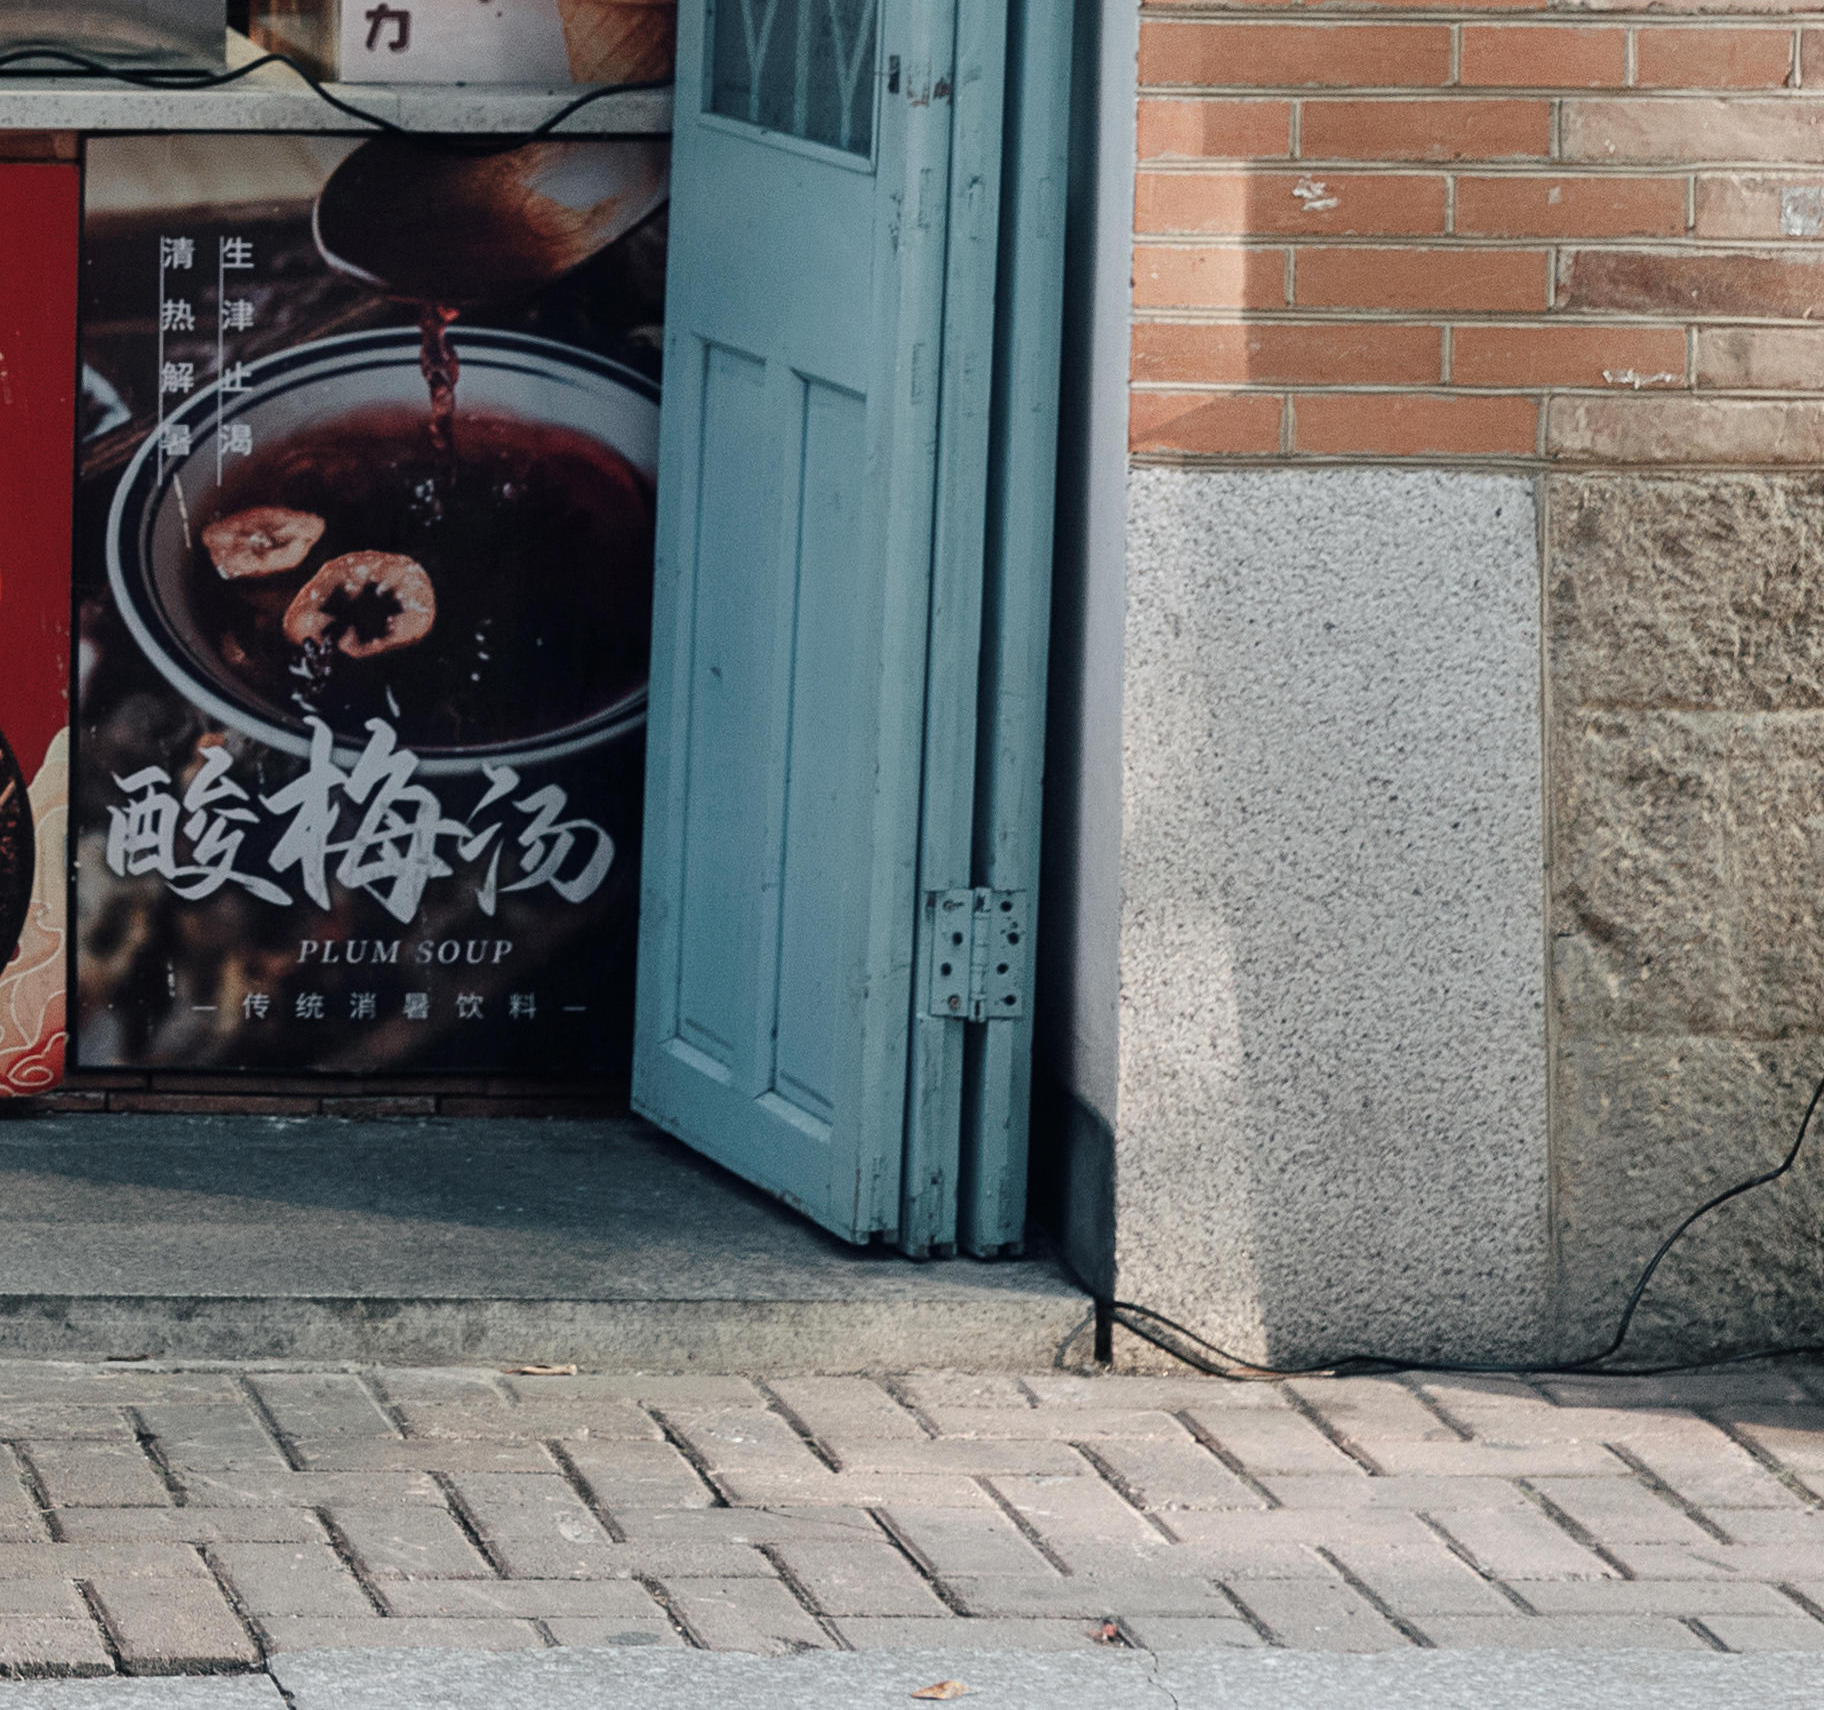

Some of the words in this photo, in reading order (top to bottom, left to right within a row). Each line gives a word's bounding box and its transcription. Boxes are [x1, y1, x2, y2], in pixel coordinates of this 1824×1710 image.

[161, 236, 196, 457] 清热解暑
[221, 236, 255, 457] 生津止渴
[105, 715, 615, 924] 酸梅汤
[241, 991, 538, 1021] 传统消暑饮料
[296, 939, 400, 965] PLUM
[414, 940, 514, 965] SOUP
